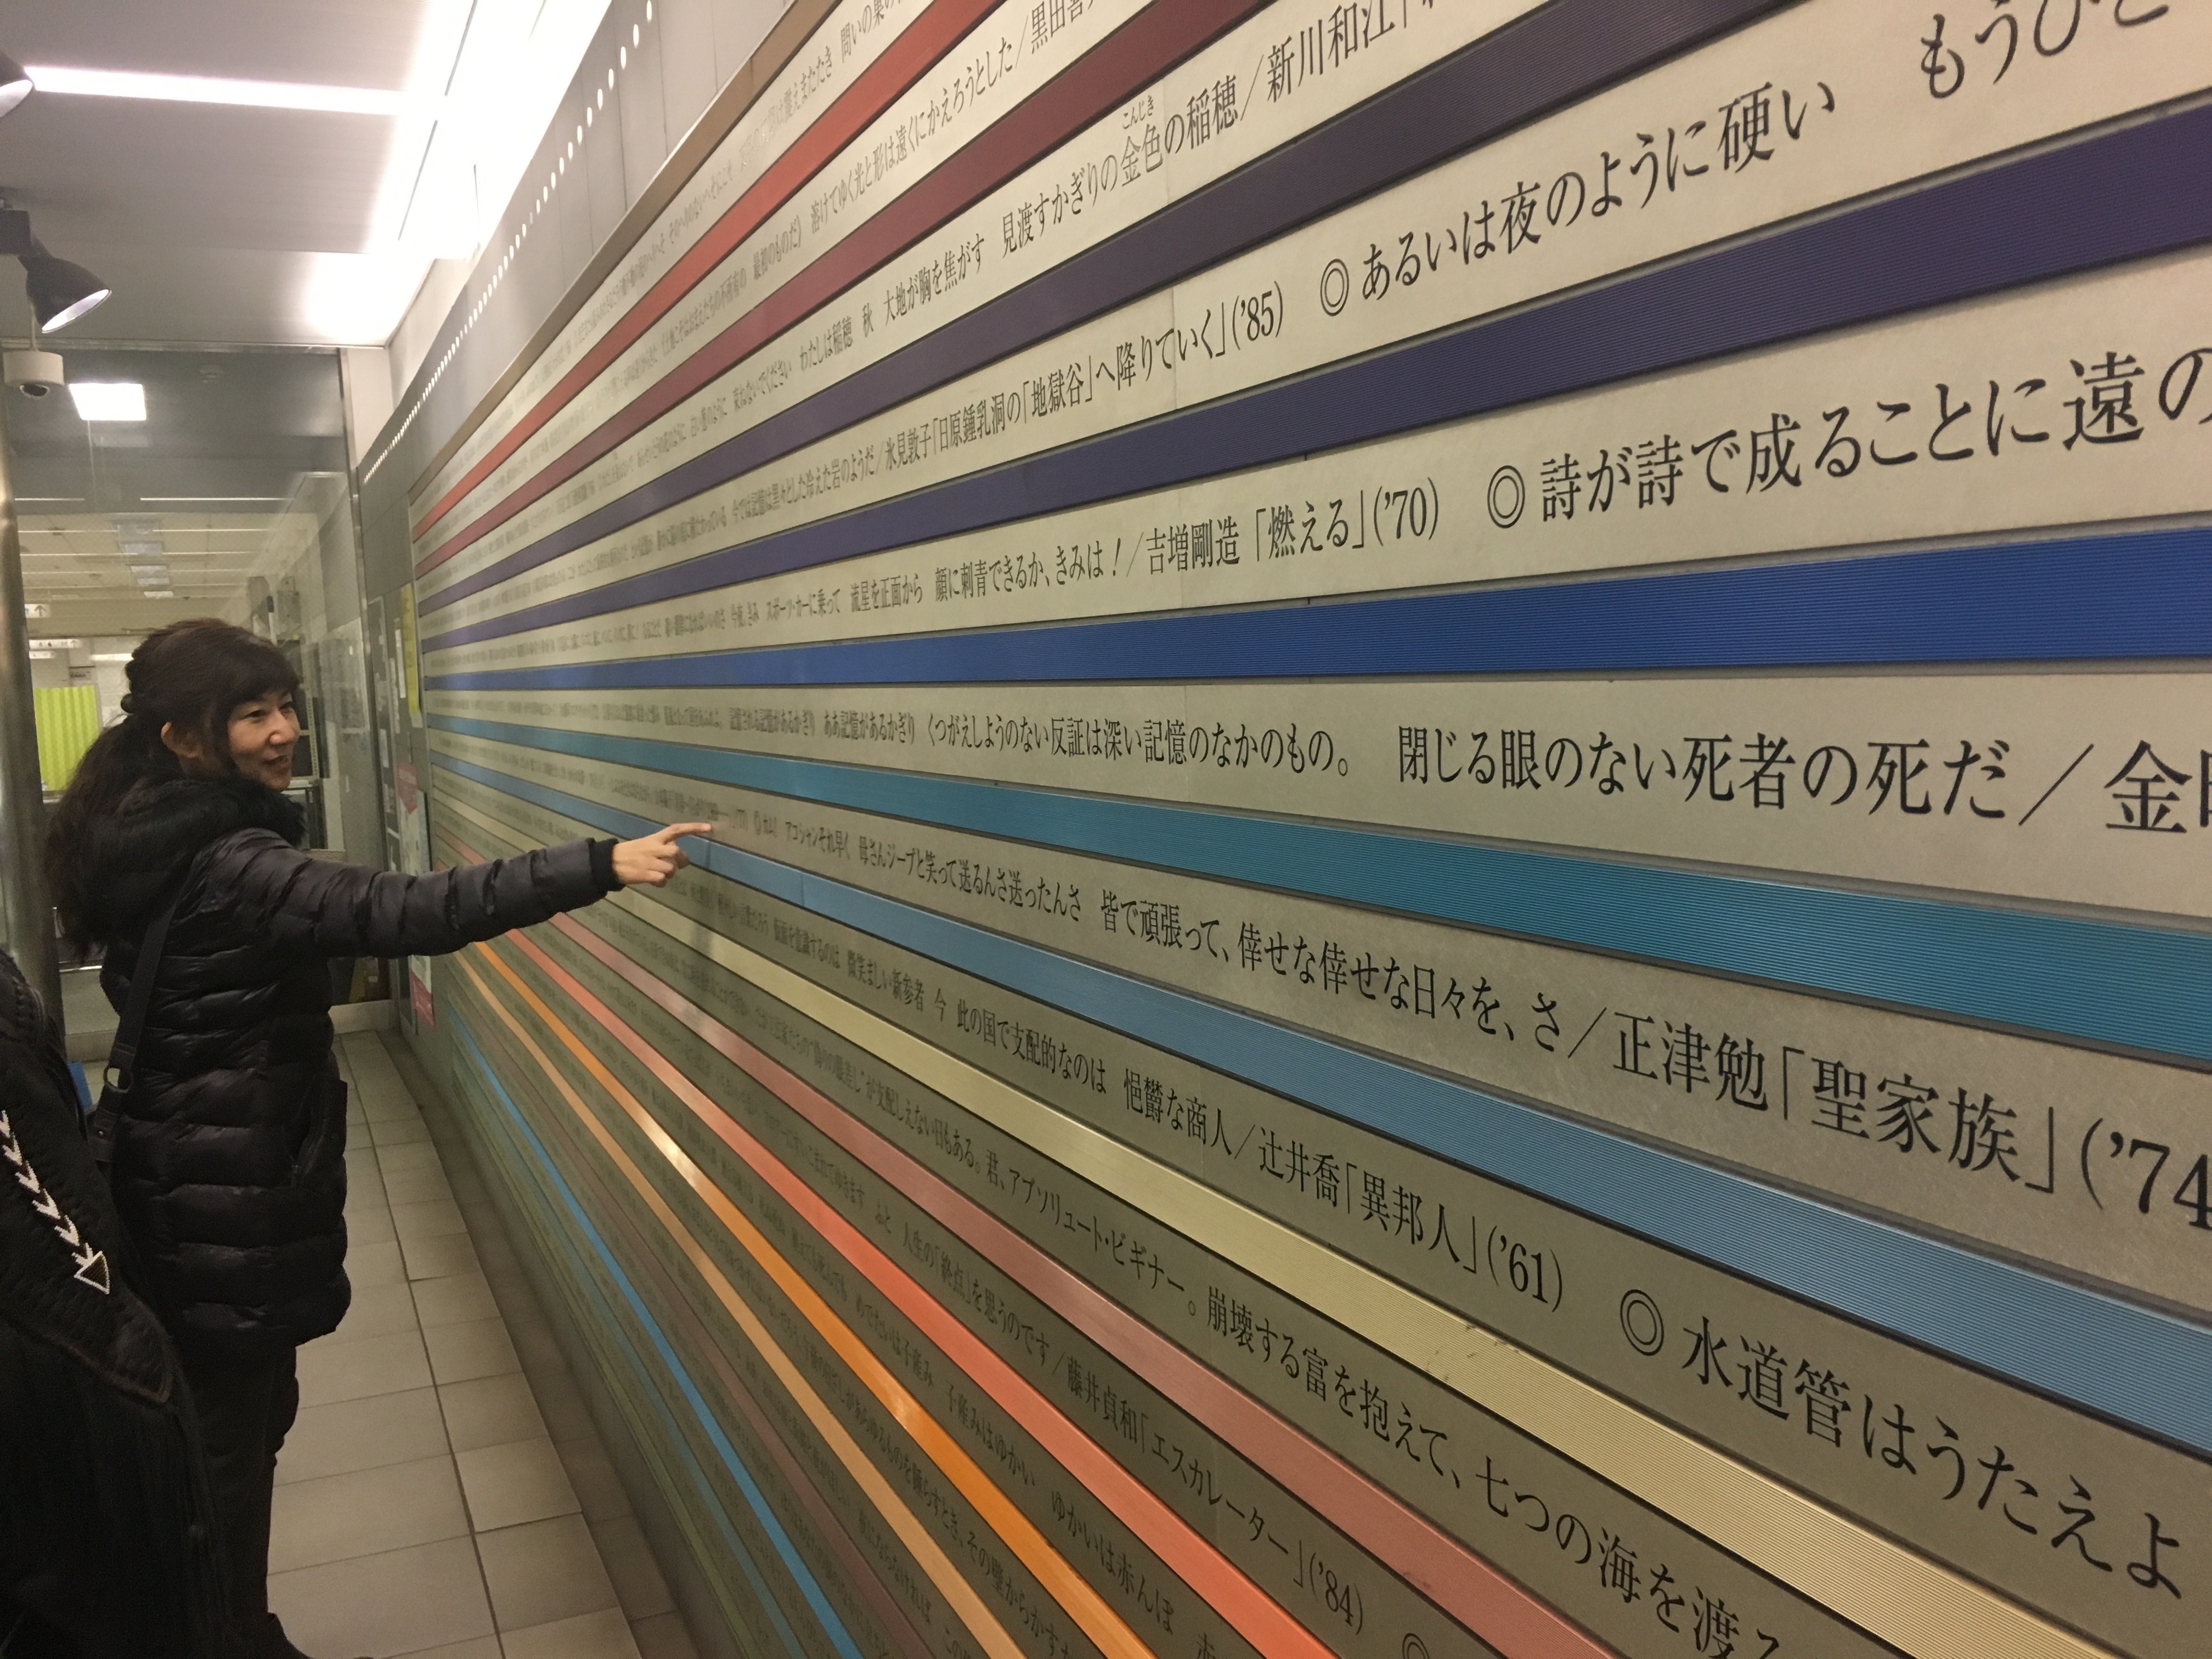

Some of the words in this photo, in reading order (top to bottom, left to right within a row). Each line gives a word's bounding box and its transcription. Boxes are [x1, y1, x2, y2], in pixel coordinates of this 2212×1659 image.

[800, 316, 853, 370] わたしは稲穂
[862, 303, 873, 337] 秋
[884, 233, 984, 324] 大地が胸を焦がす
[1003, 0, 1437, 257] 見渡すかぎりの金色の稲穂／新川和江
[1121, 94, 1155, 130] こんじき
[1362, 82, 1836, 300] あるいは夜のように硬い
[851, 573, 922, 612] 流星を正面から
[1541, 337, 2211, 521] 詩が詩で成ることに遠の
[824, 711, 914, 743] ああ記憶があるかぎり
[928, 714, 1347, 776] くつがえしようのない反証は深い記憶のなかのもの。
[1399, 726, 2211, 832] 閉じる眼のない死者の死だ／金
[859, 836, 1080, 922] 母さんジープと笑って送るんさ送ったんさ
[934, 988, 946, 1021] 今
[957, 999, 1105, 1094] 此の国で支配的なのは
[1681, 1317, 2183, 1599] 水道管はうたえよ
